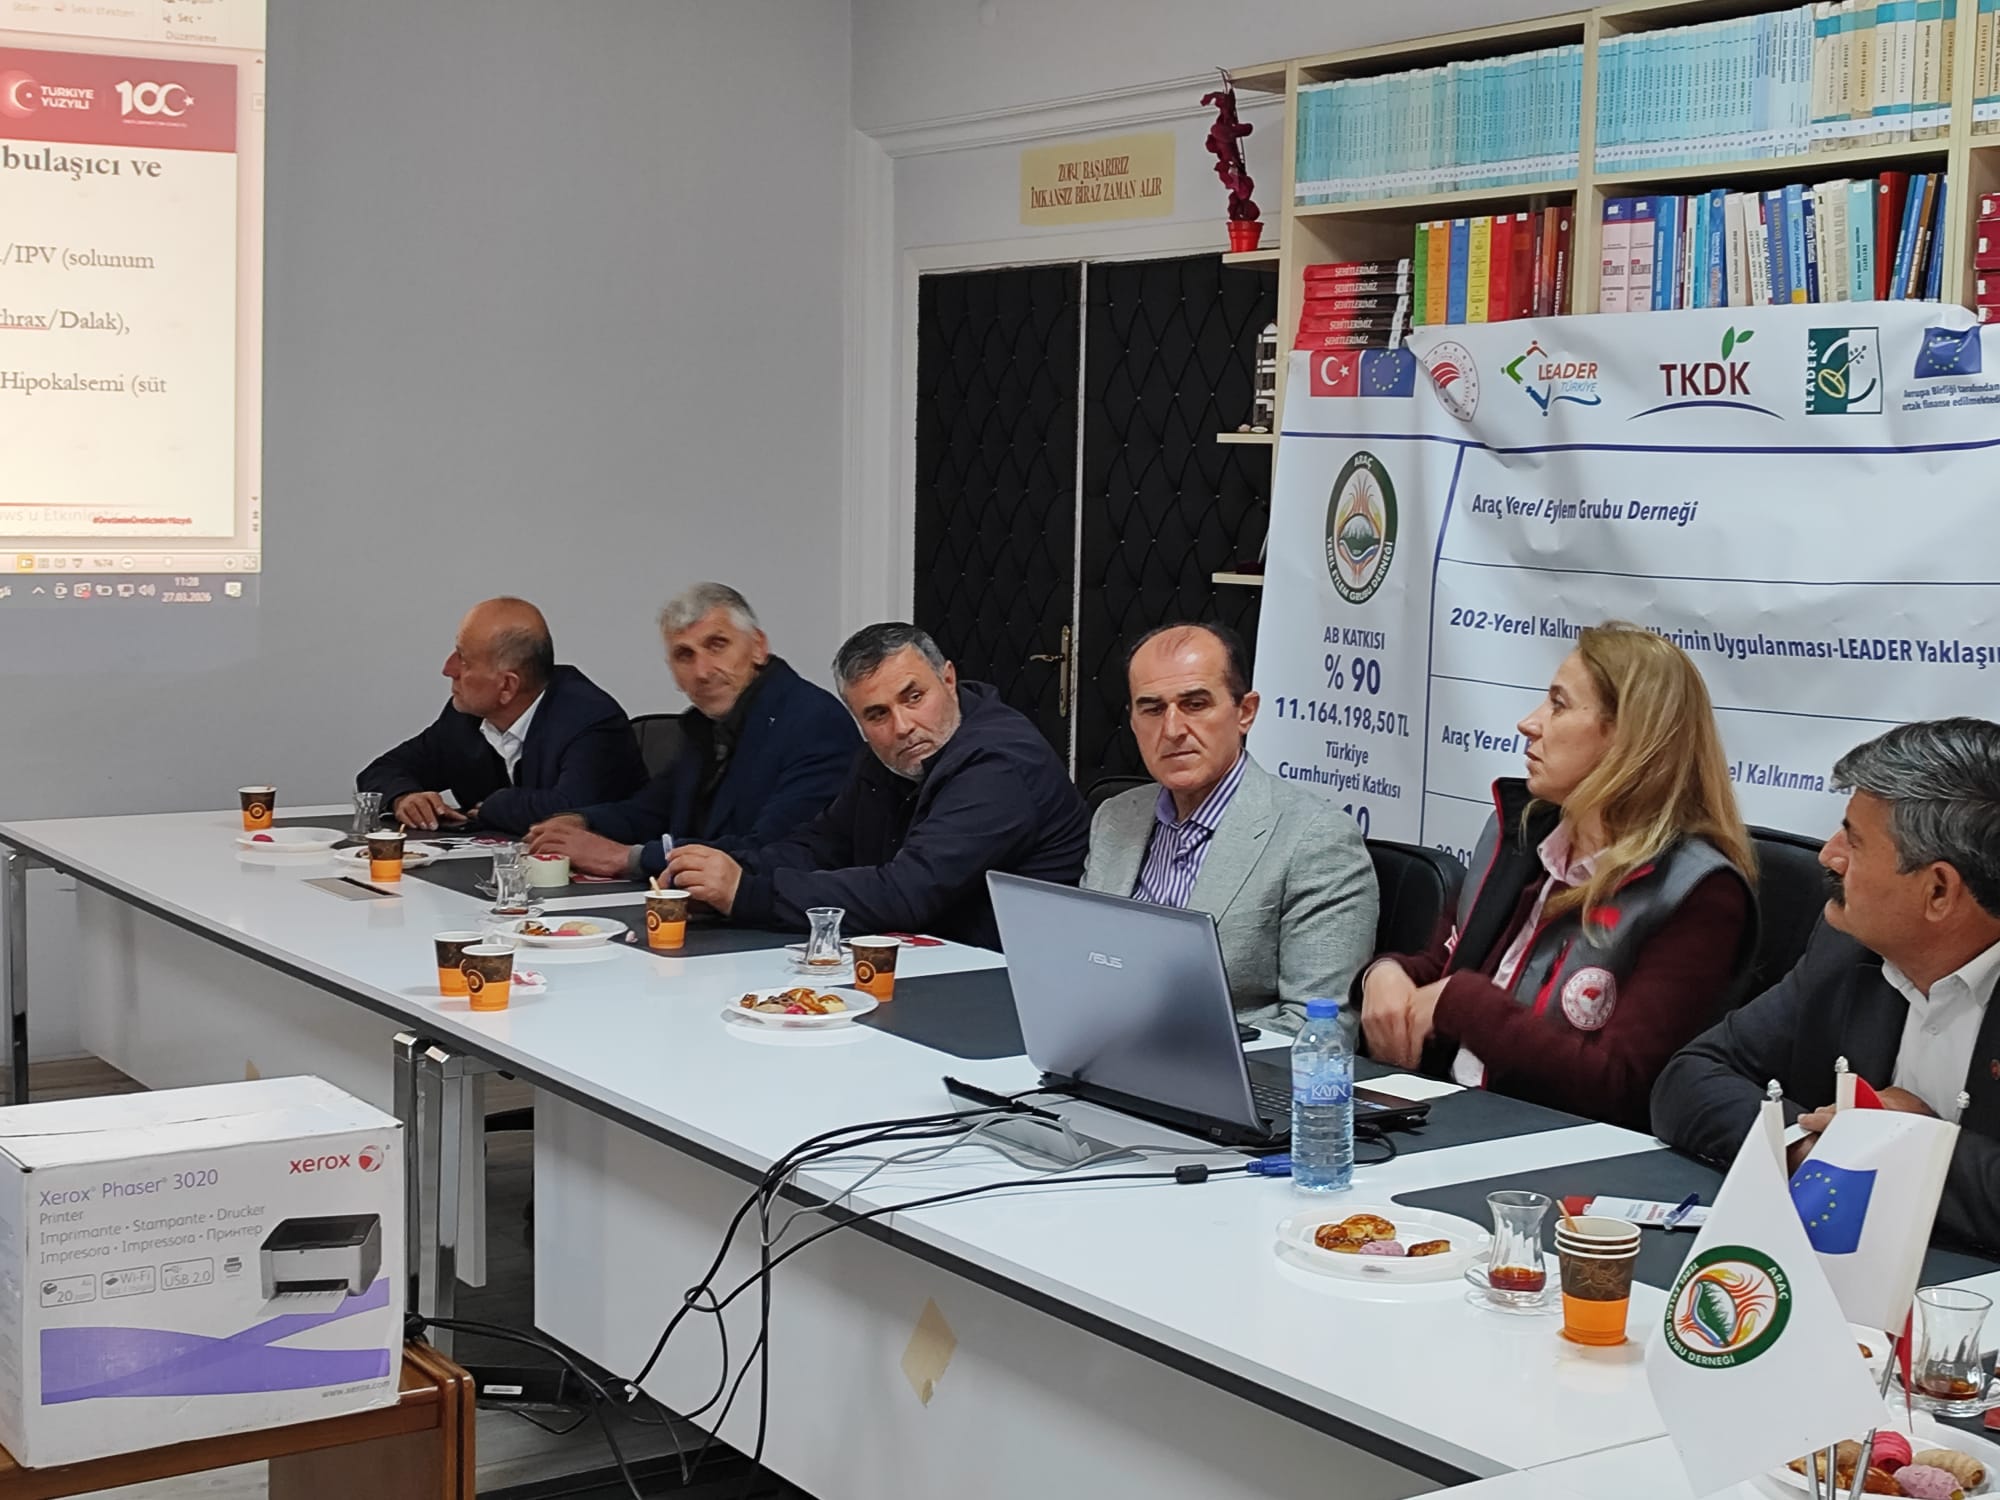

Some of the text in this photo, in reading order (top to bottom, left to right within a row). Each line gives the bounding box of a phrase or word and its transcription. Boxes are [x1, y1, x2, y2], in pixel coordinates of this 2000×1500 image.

[3, 146, 162, 181] bulaşıcı ve
[1104, 180, 1137, 202] ZAMAN
[1139, 177, 1162, 198] ALIR
[0, 242, 155, 271] /IPV (solunum
[1, 371, 167, 397] Hipokalsemi (süt
[1538, 362, 1598, 382] LEADER
[1659, 361, 1751, 397] TKDK
[1805, 347, 1818, 412] LEADER
[1472, 494, 1699, 528] Araç Yerel Eylem Grubu Derneği
[1324, 626, 1385, 650] AB KATKISI
[1450, 607, 1535, 636] 202-Yerel
[1540, 617, 1600, 641] Kalkın
[1713, 632, 1912, 661] Uygulanması-LEADER
[1915, 639, 2000, 669] Yaklaşı
[1325, 653, 1381, 695] % 90
[1325, 740, 1369, 767] Türkiye
[1442, 724, 1470, 752] Araç
[1474, 729, 1520, 754] Yerel
[1278, 761, 1401, 799] Cumhuriyeti Katkısı
[1746, 763, 1825, 792] Kalkınma
[289, 1152, 351, 1175] xerox
[173, 1168, 219, 1190] 3020
[40, 1209, 84, 1225] Printer
[40, 1204, 266, 1245] Imprimante Stampante Drucker
[206, 1223, 263, 1242] Принтер
[40, 1233, 196, 1265] Impresora Impressora
[120, 1271, 151, 1285] Wi-Fi
[164, 1273, 189, 1287] USB
[193, 1270, 211, 1284] 2.0
[57, 1290, 73, 1303] 20
[1666, 1322, 1688, 1356] GRUBU
